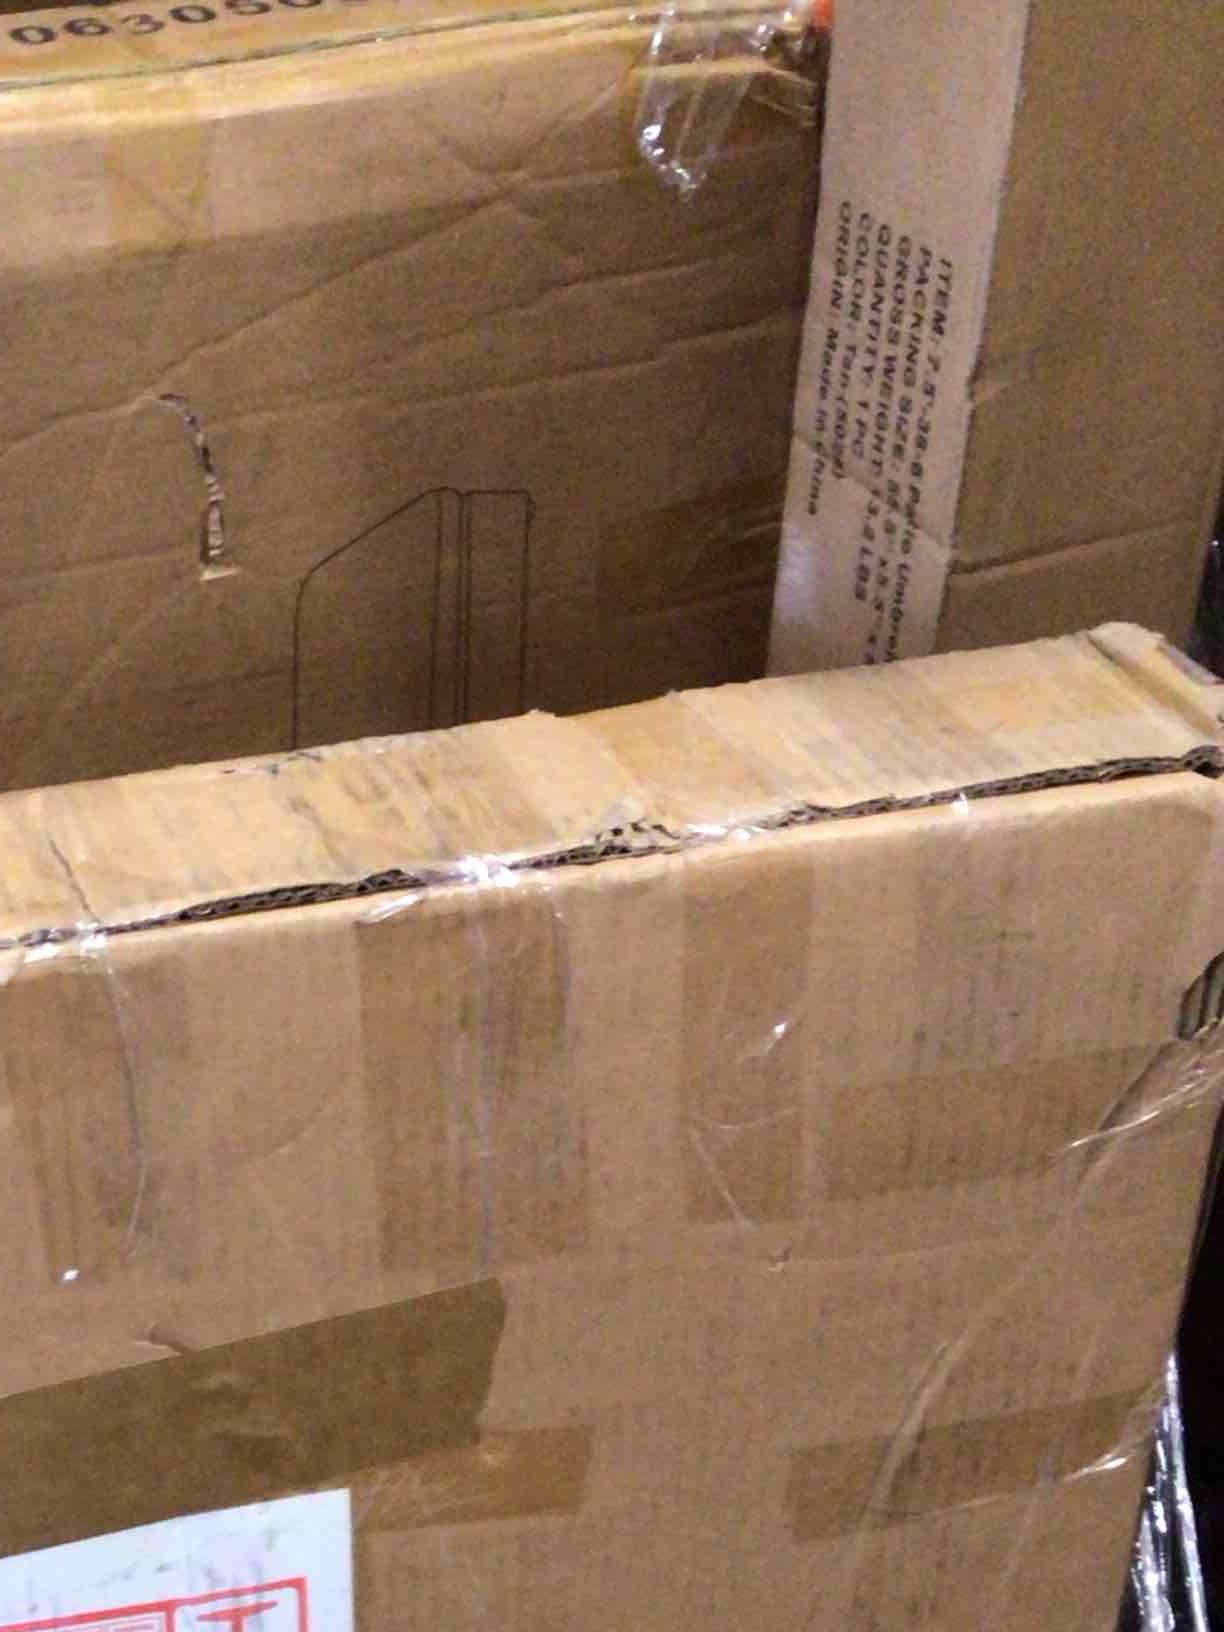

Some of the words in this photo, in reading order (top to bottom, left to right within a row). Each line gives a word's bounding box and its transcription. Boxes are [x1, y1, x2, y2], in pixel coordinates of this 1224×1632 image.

[848, 213, 873, 331] COLOR:
[862, 224, 891, 387] QUANTITY:
[887, 235, 913, 346] GROSS
[903, 247, 933, 388] PACKING
[819, 328, 839, 399] Made
[807, 436, 828, 516] China
